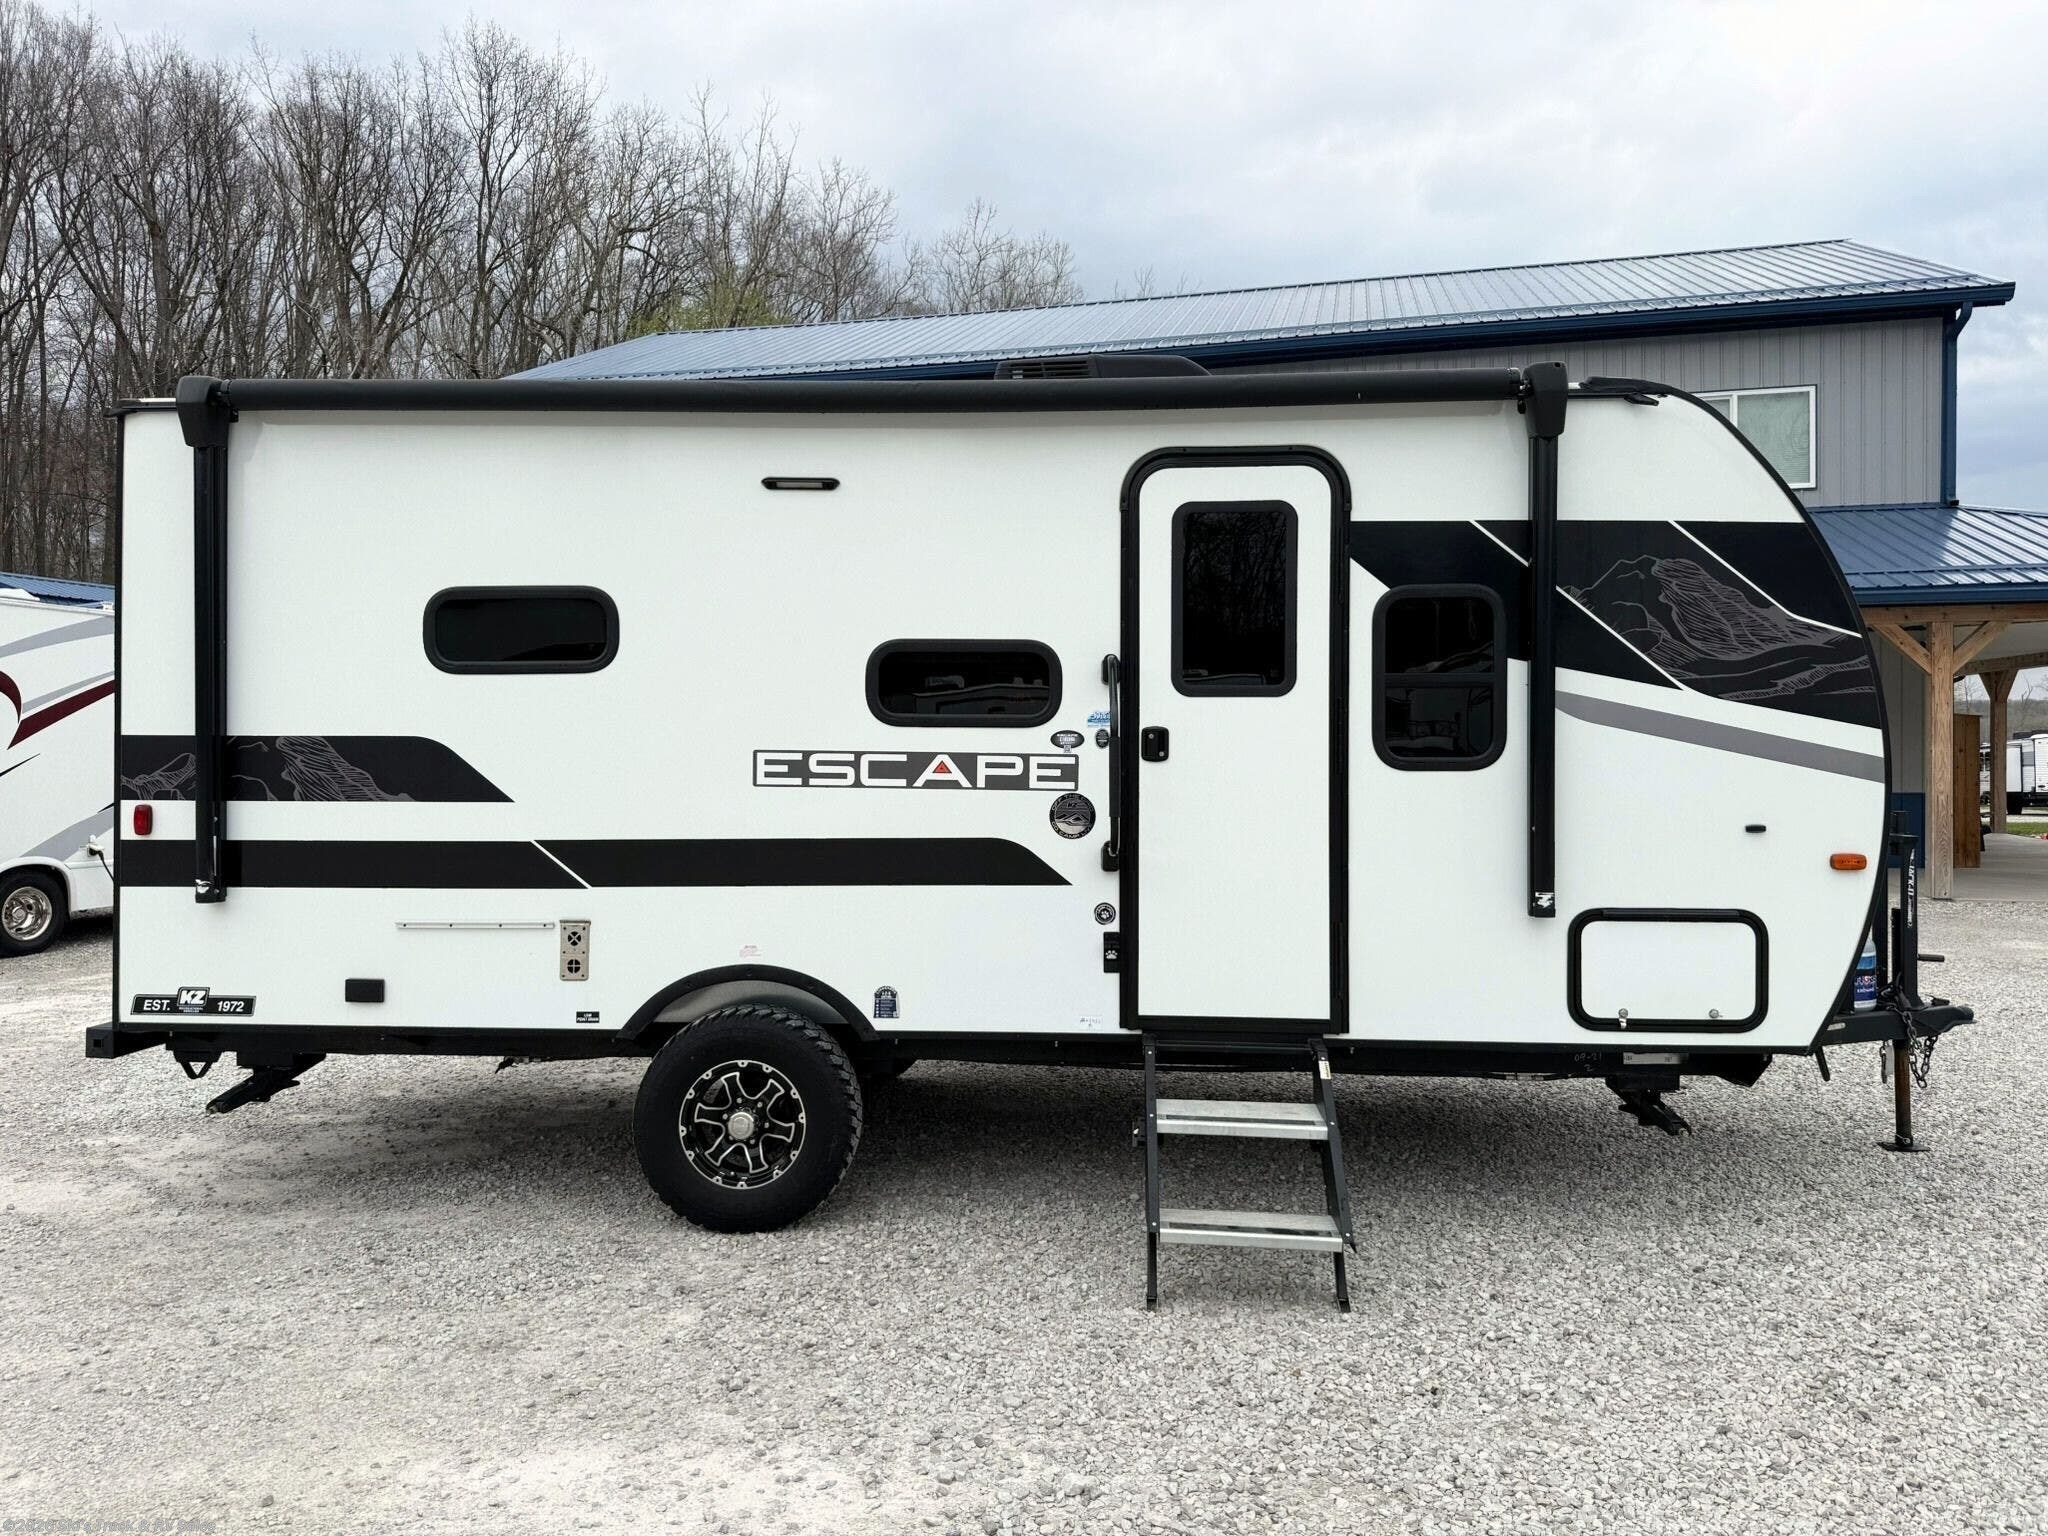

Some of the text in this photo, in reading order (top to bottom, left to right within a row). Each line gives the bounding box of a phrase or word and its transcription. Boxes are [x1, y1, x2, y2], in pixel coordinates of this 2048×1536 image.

[757, 752, 1076, 789] ESCAPE
[180, 990, 206, 1004] KZ
[143, 1000, 244, 1012] EST. 1972
